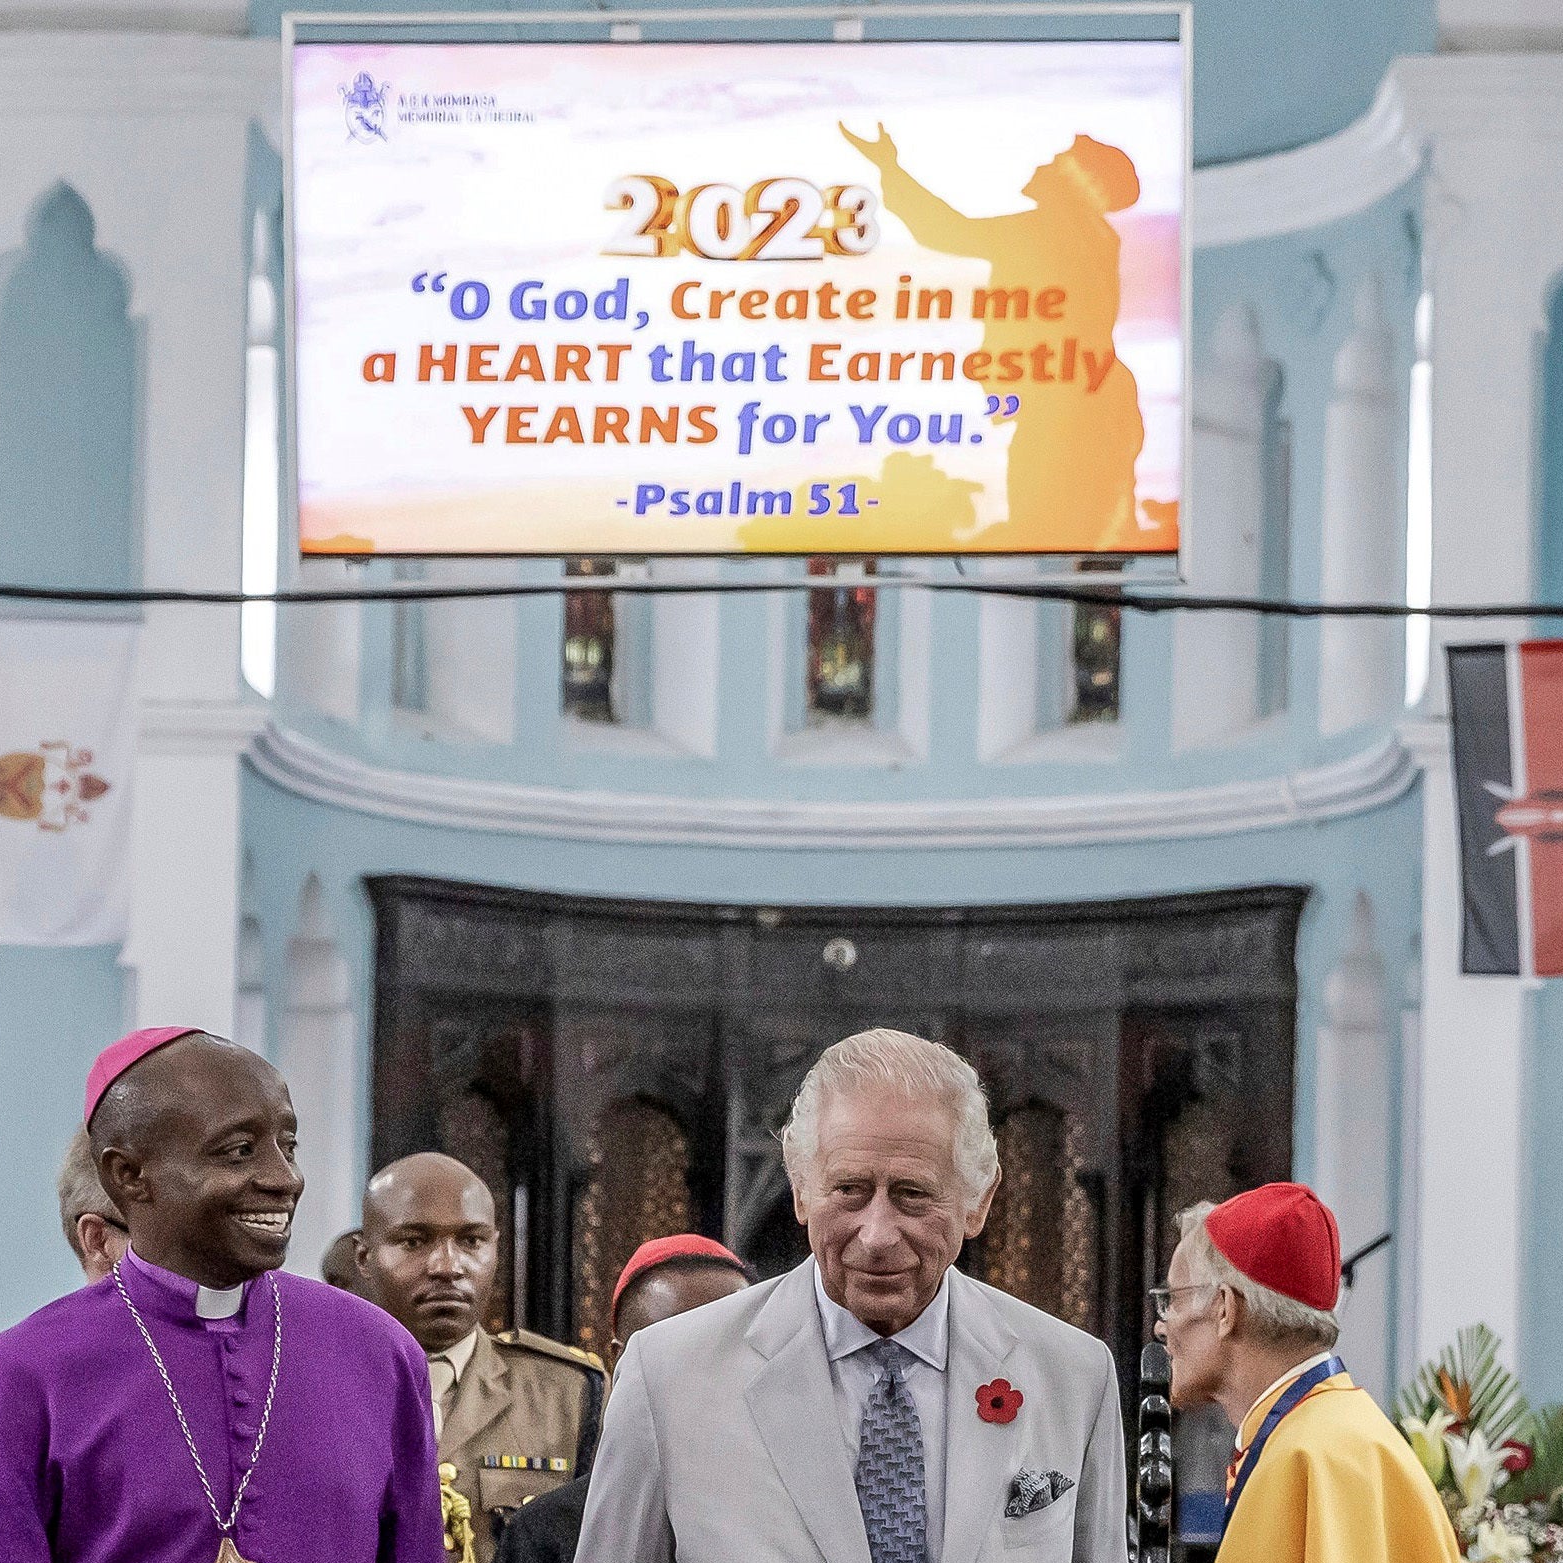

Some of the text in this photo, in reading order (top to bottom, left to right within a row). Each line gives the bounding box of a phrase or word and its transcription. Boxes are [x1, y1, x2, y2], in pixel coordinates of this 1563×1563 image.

[600, 175, 880, 260] 2023
[509, 278, 649, 330] God,
[671, 281, 877, 320] Create
[896, 275, 953, 319] in
[972, 287, 1066, 320] me
[363, 337, 1115, 393] a HEART that Earnestly
[461, 405, 718, 444] YEARNS
[738, 401, 830, 455] for
[616, 482, 879, 516] -Psalm 51-
